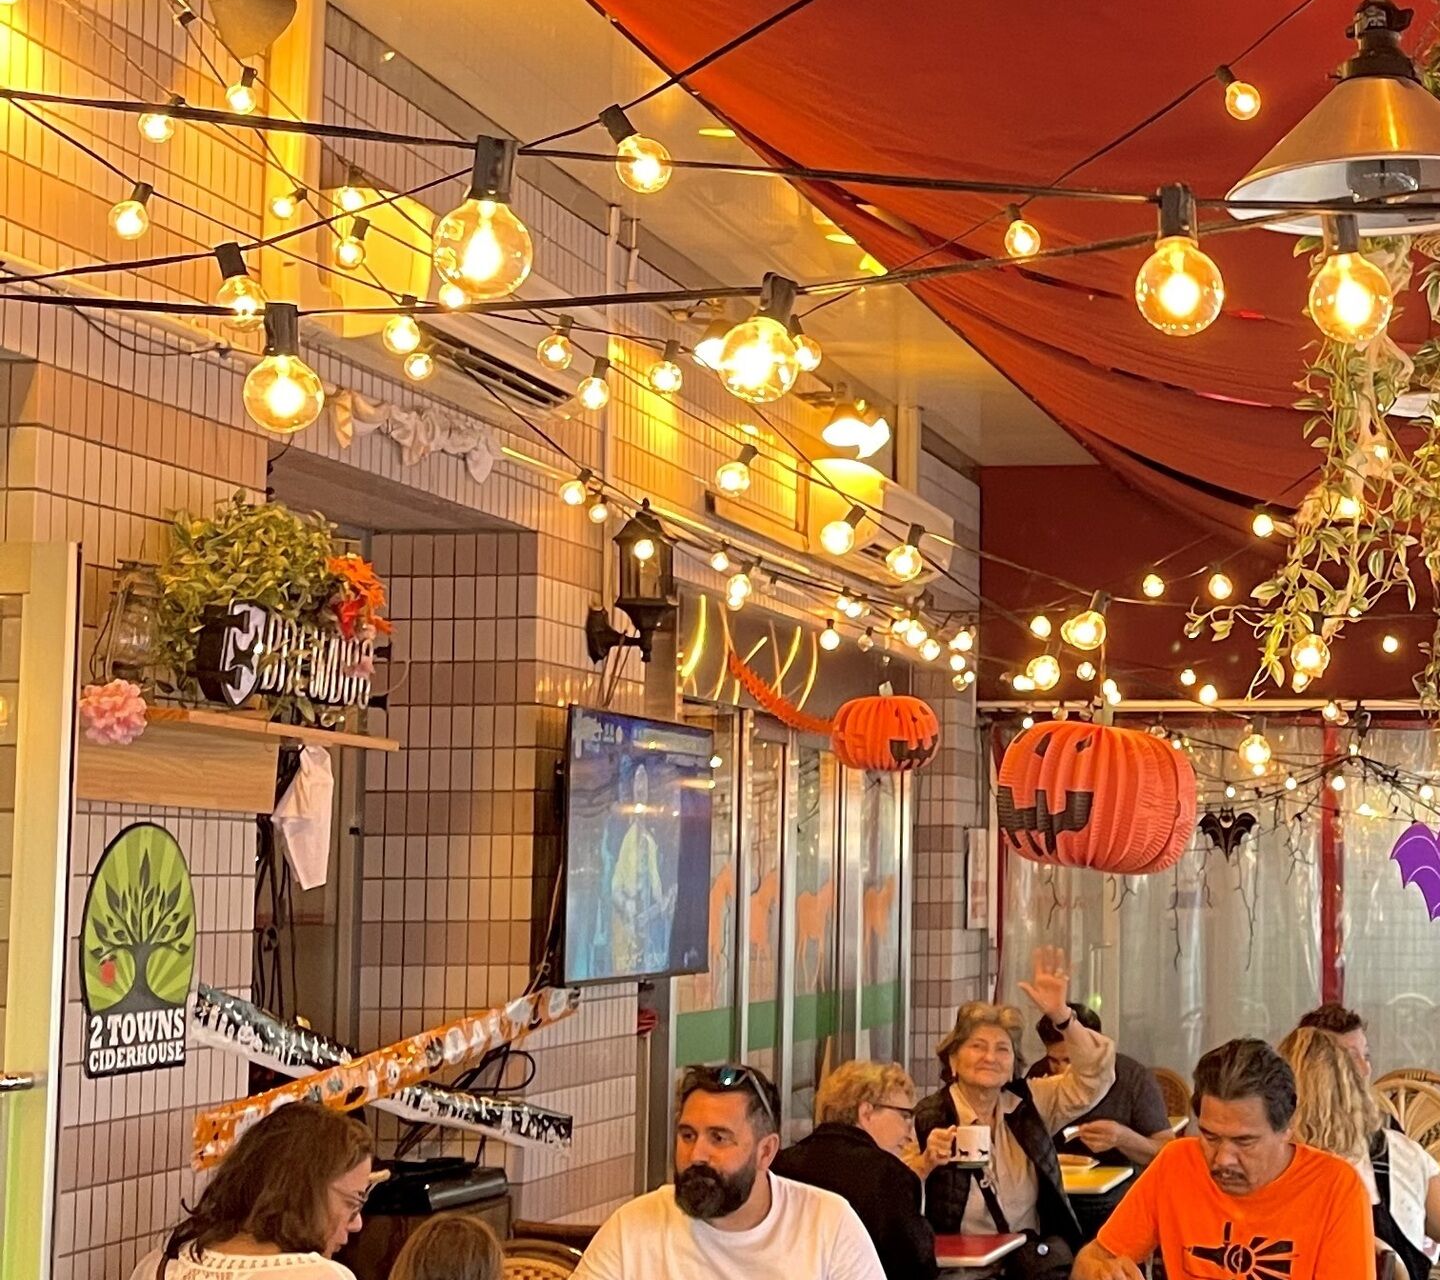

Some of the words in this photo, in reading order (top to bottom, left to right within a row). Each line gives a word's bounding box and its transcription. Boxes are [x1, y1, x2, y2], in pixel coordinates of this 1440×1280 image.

[89, 1014, 104, 1050] 2
[106, 1007, 185, 1047] TOWNS
[88, 1039, 185, 1073] CIDERHOUSE
